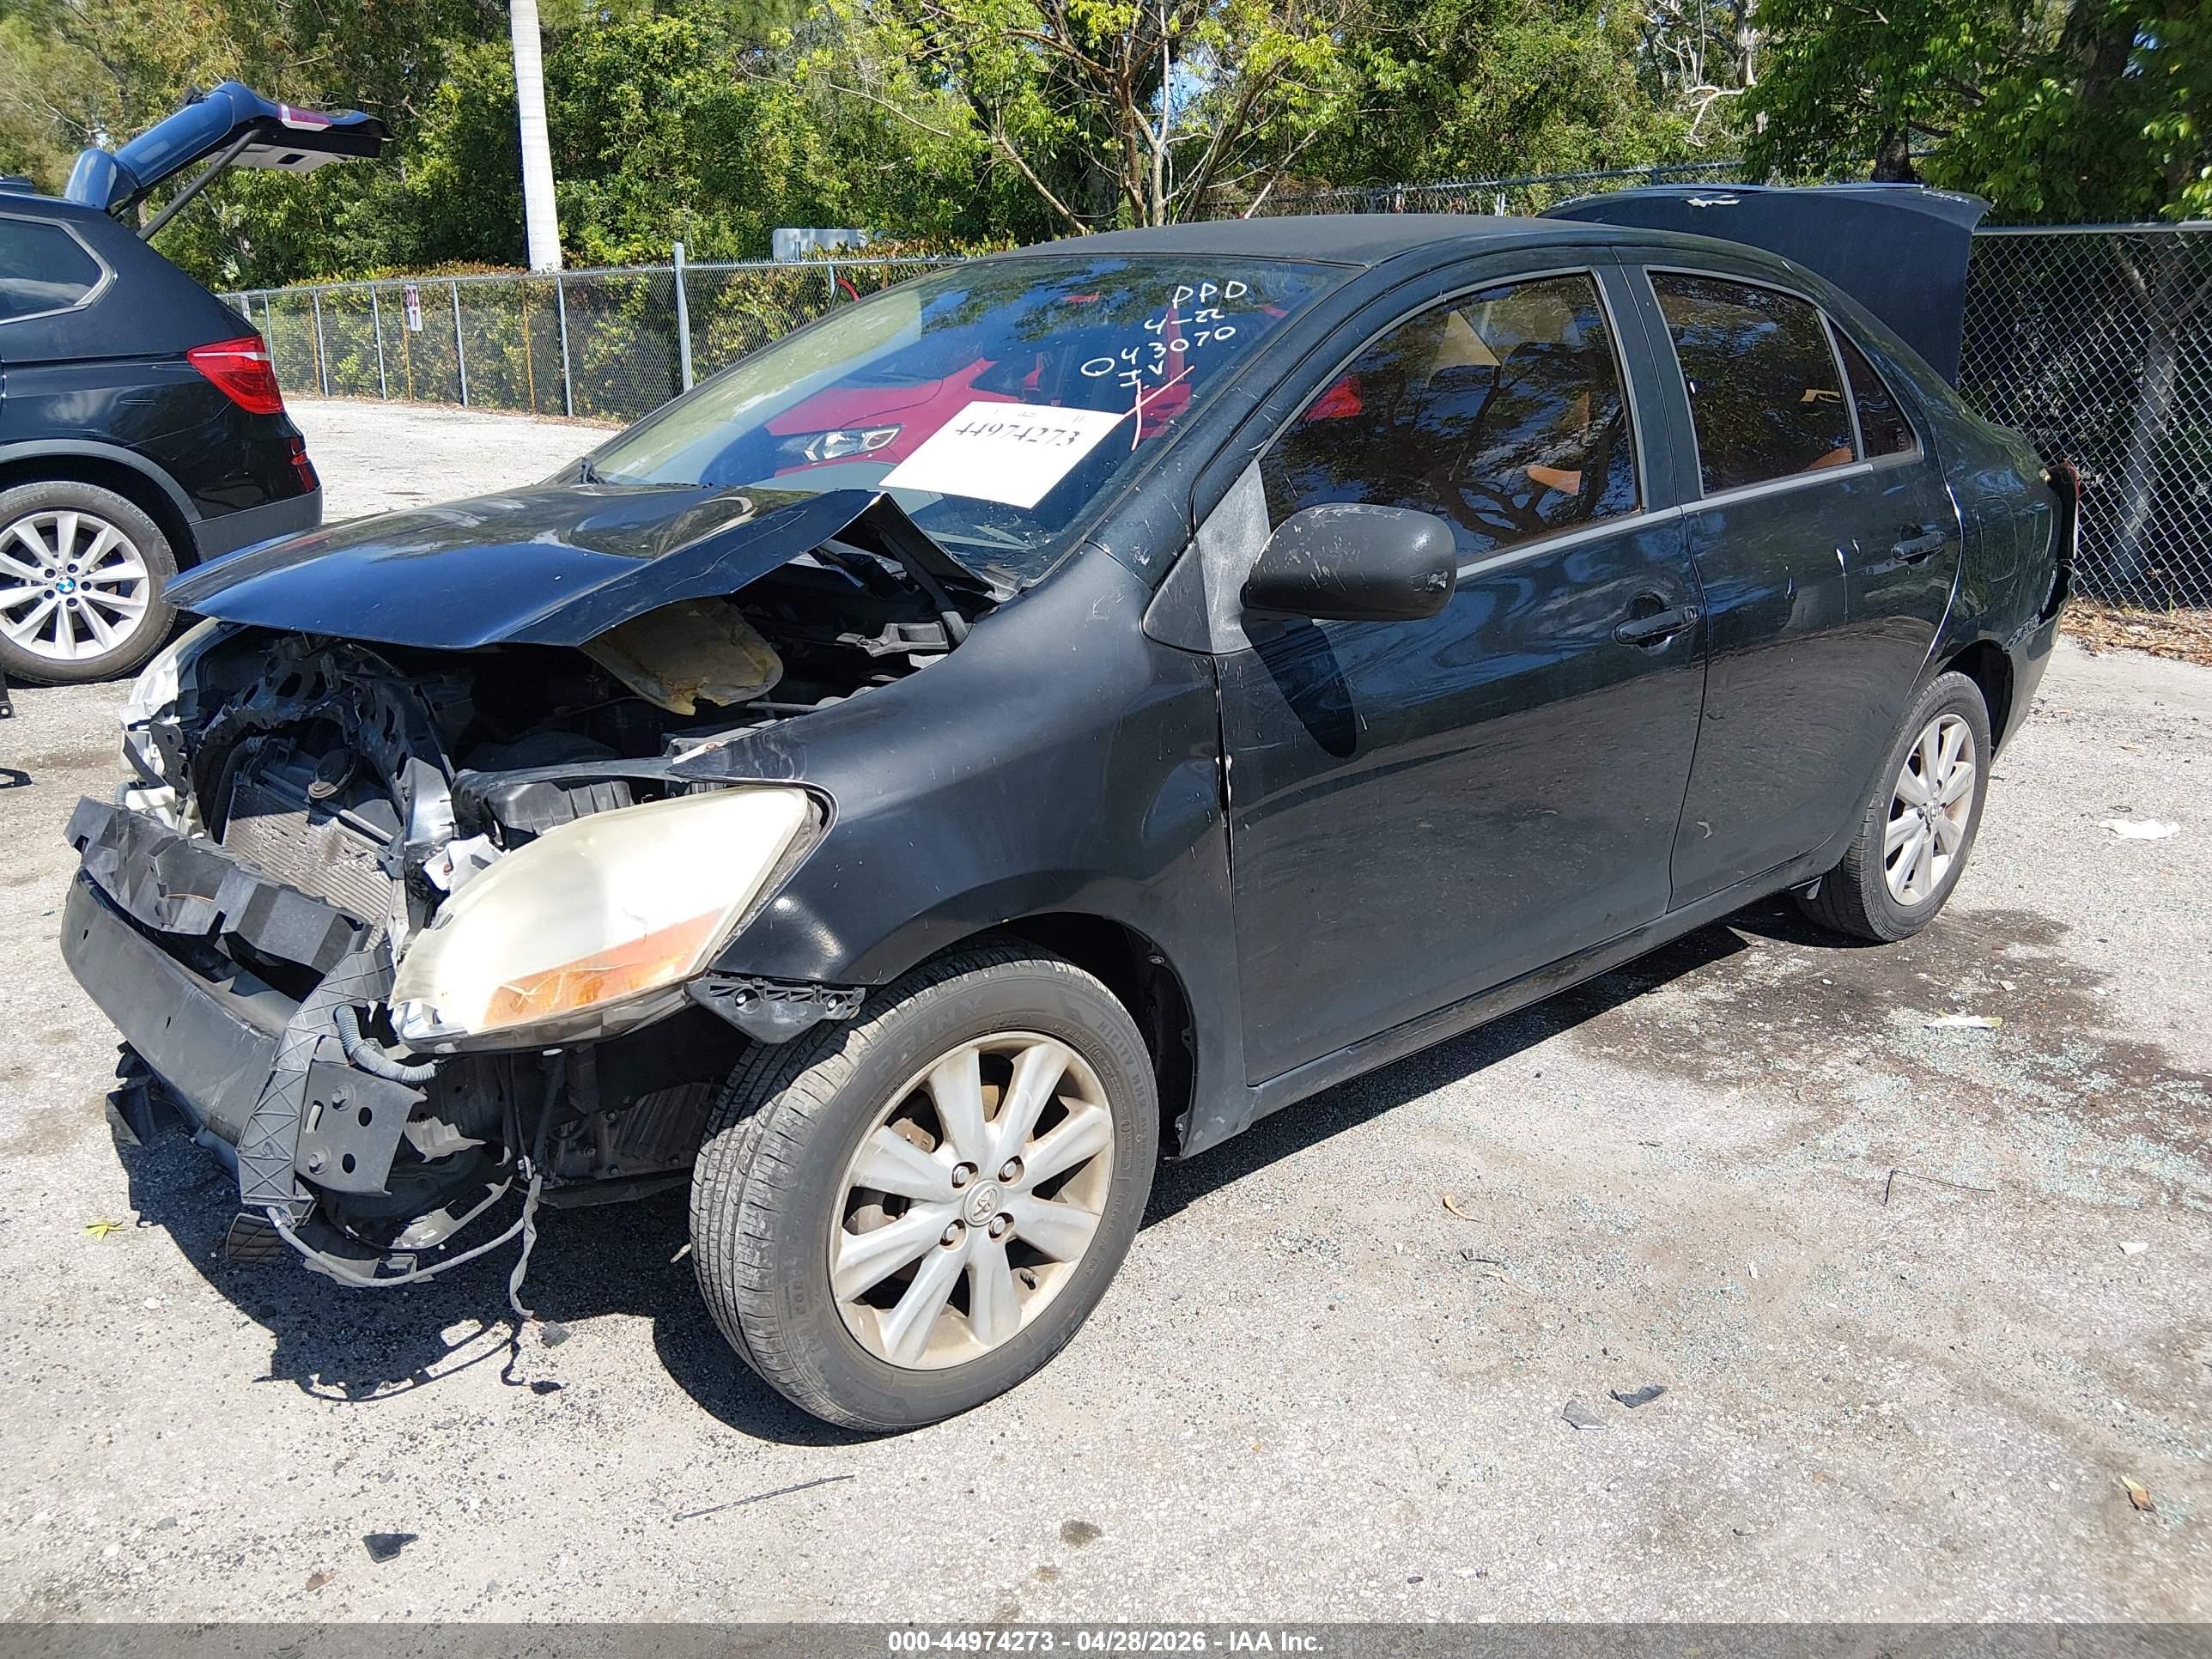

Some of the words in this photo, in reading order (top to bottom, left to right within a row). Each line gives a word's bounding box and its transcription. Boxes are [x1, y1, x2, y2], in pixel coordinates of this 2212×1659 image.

[1144, 308, 1224, 334] 4-22
[1080, 326, 1236, 376] 043070
[873, 996, 983, 1080] PRINX
